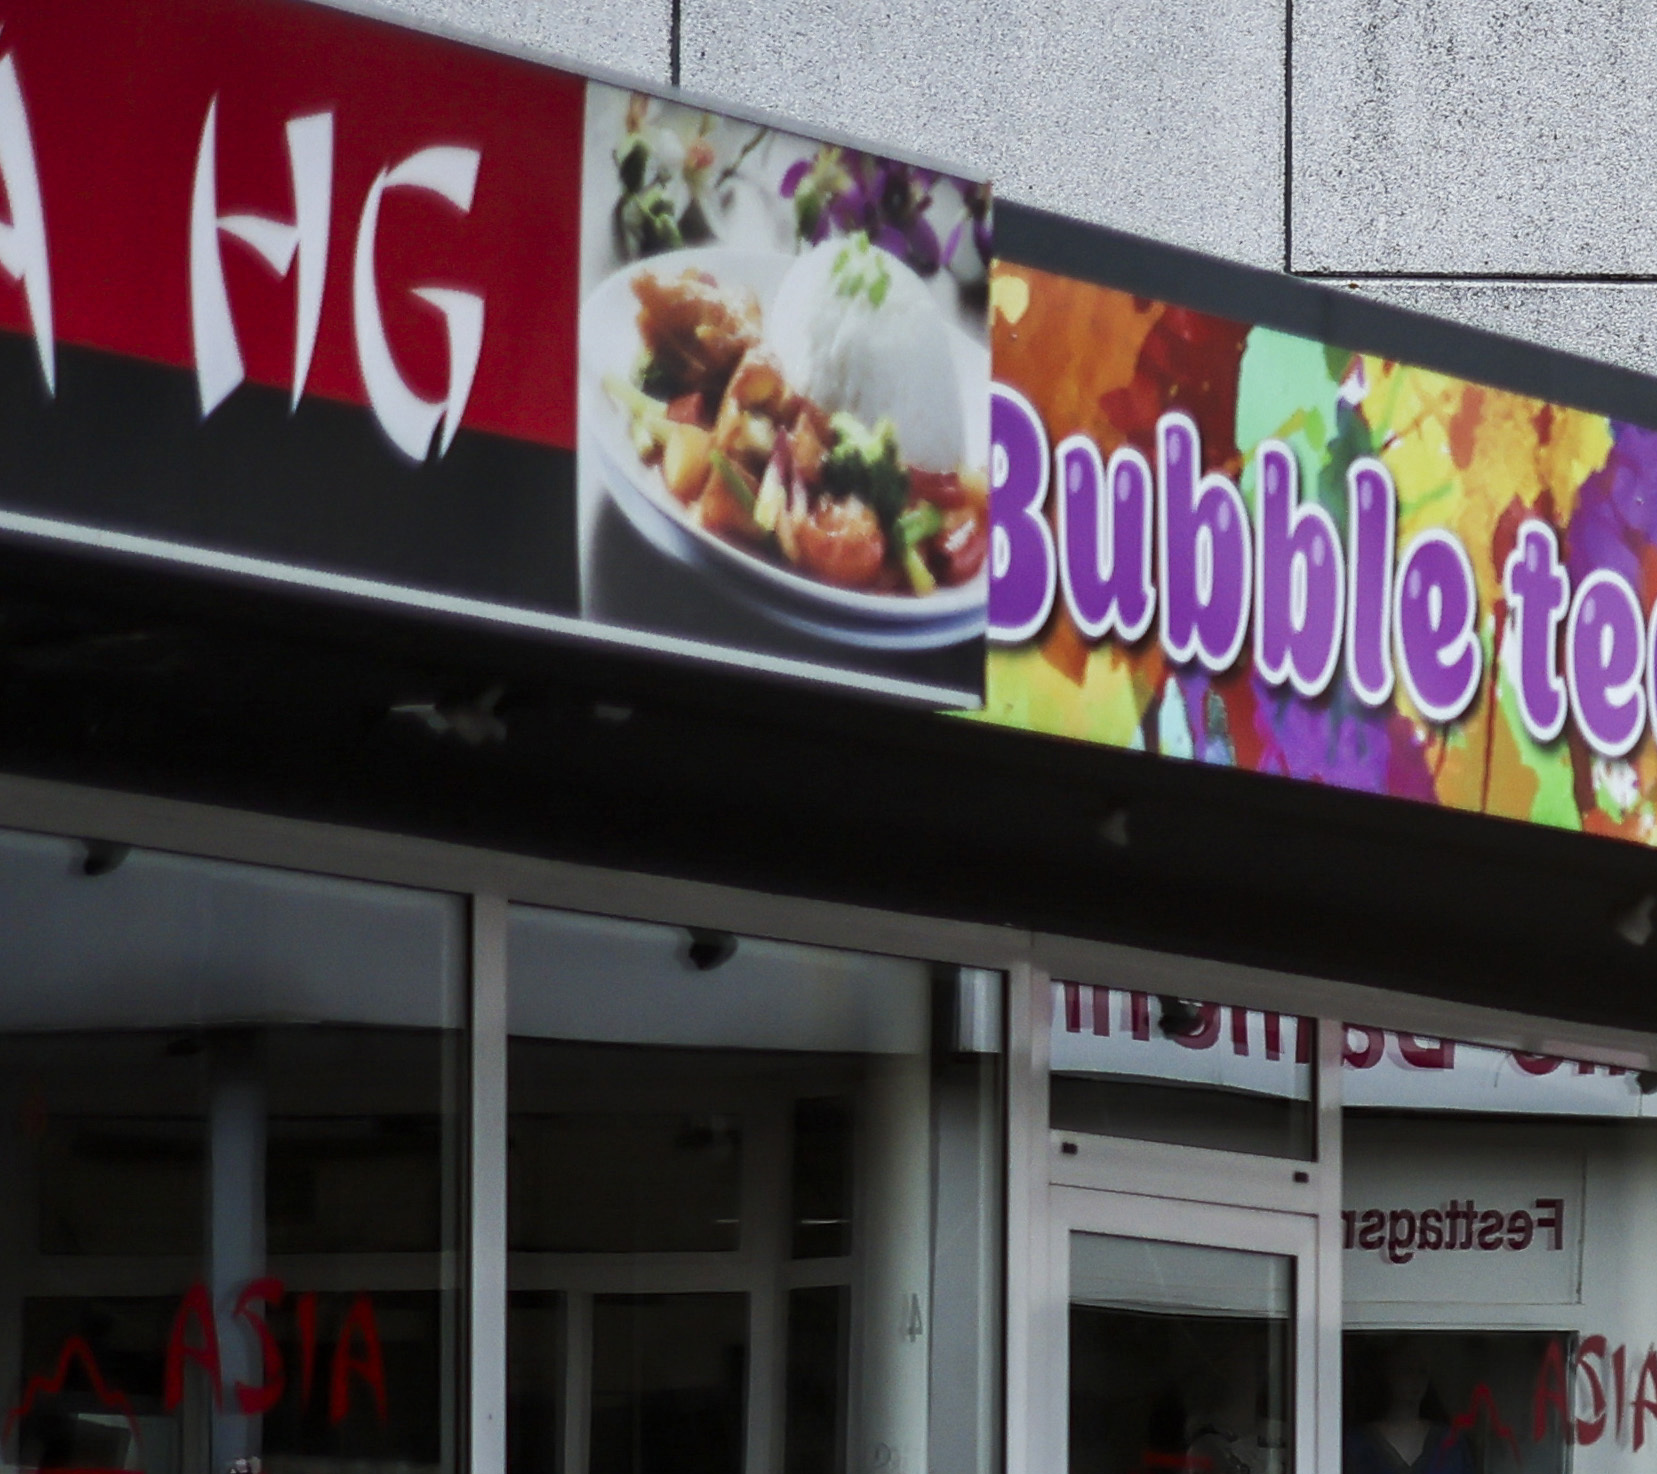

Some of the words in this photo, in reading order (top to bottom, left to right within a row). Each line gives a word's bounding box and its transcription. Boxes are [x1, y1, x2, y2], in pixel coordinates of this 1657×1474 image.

[188, 90, 485, 465] HG
[988, 382, 1482, 724] Bubble
[164, 1278, 390, 1428] ASIA
